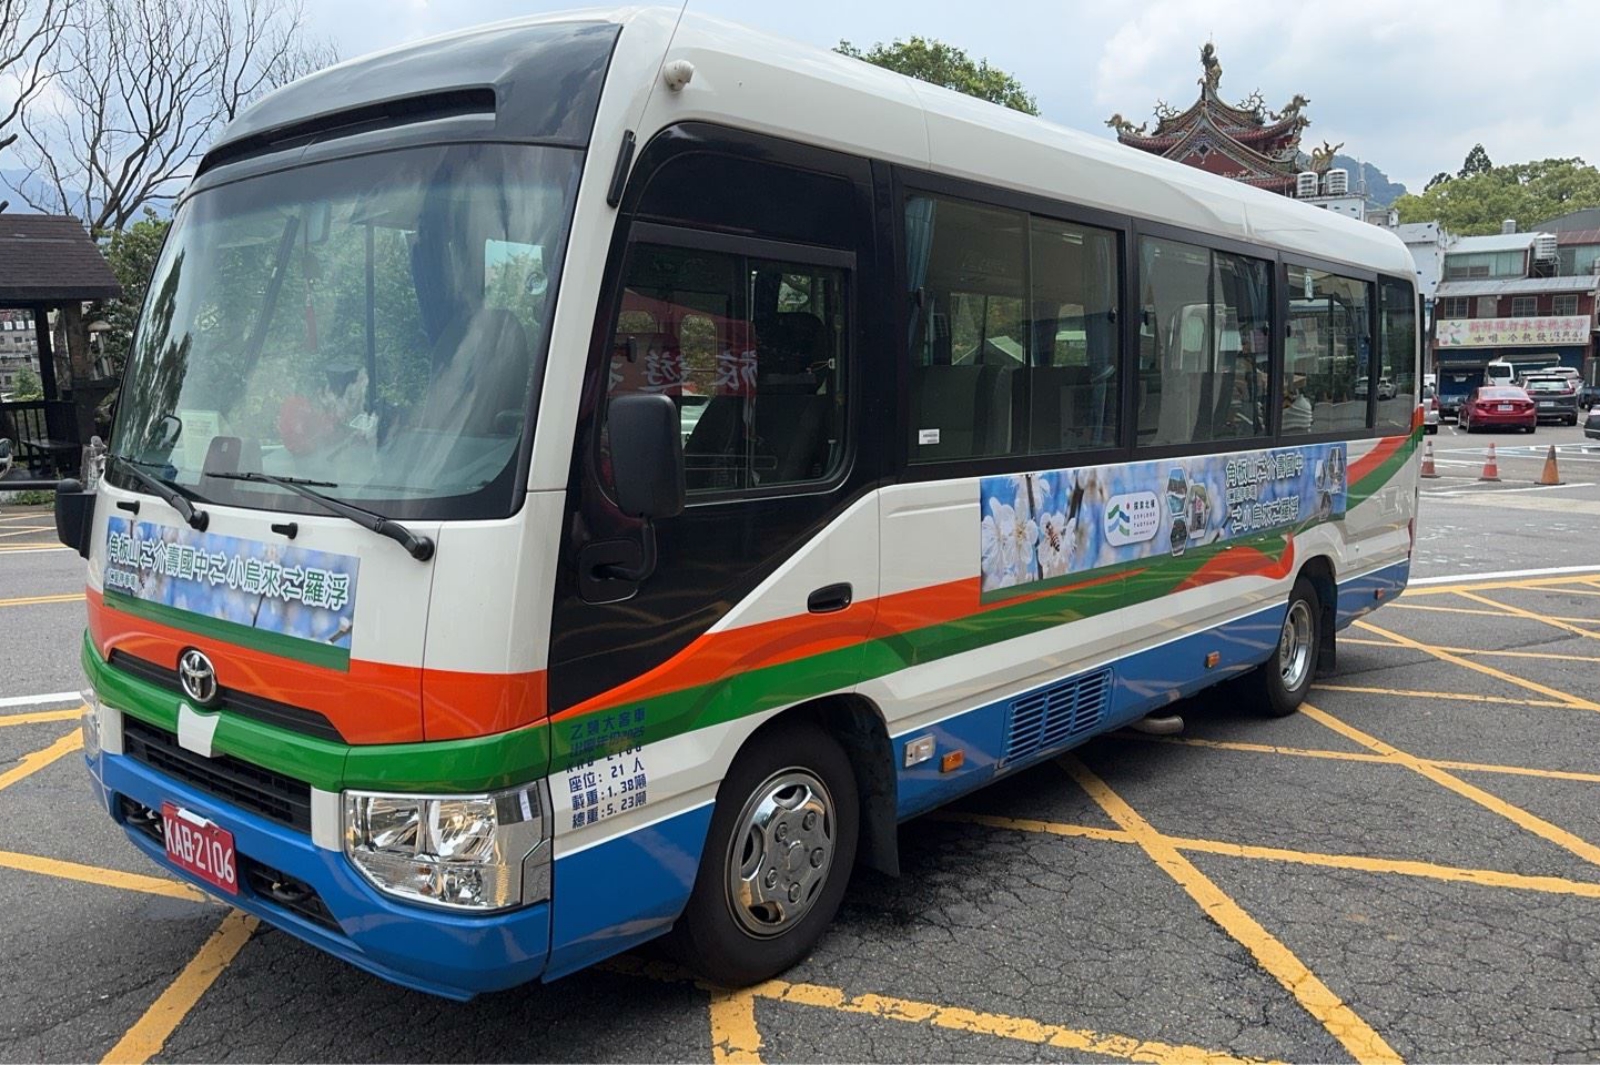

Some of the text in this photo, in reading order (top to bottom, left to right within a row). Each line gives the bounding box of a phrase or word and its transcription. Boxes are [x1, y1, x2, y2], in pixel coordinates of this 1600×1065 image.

[108, 531, 141, 568] 角板山
[152, 539, 209, 582] 介壽國中
[226, 556, 282, 597] 小烏來
[302, 567, 349, 611] 羅浮
[611, 763, 625, 779] 21
[633, 757, 645, 773] 人
[163, 816, 235, 884] KAB-2106
